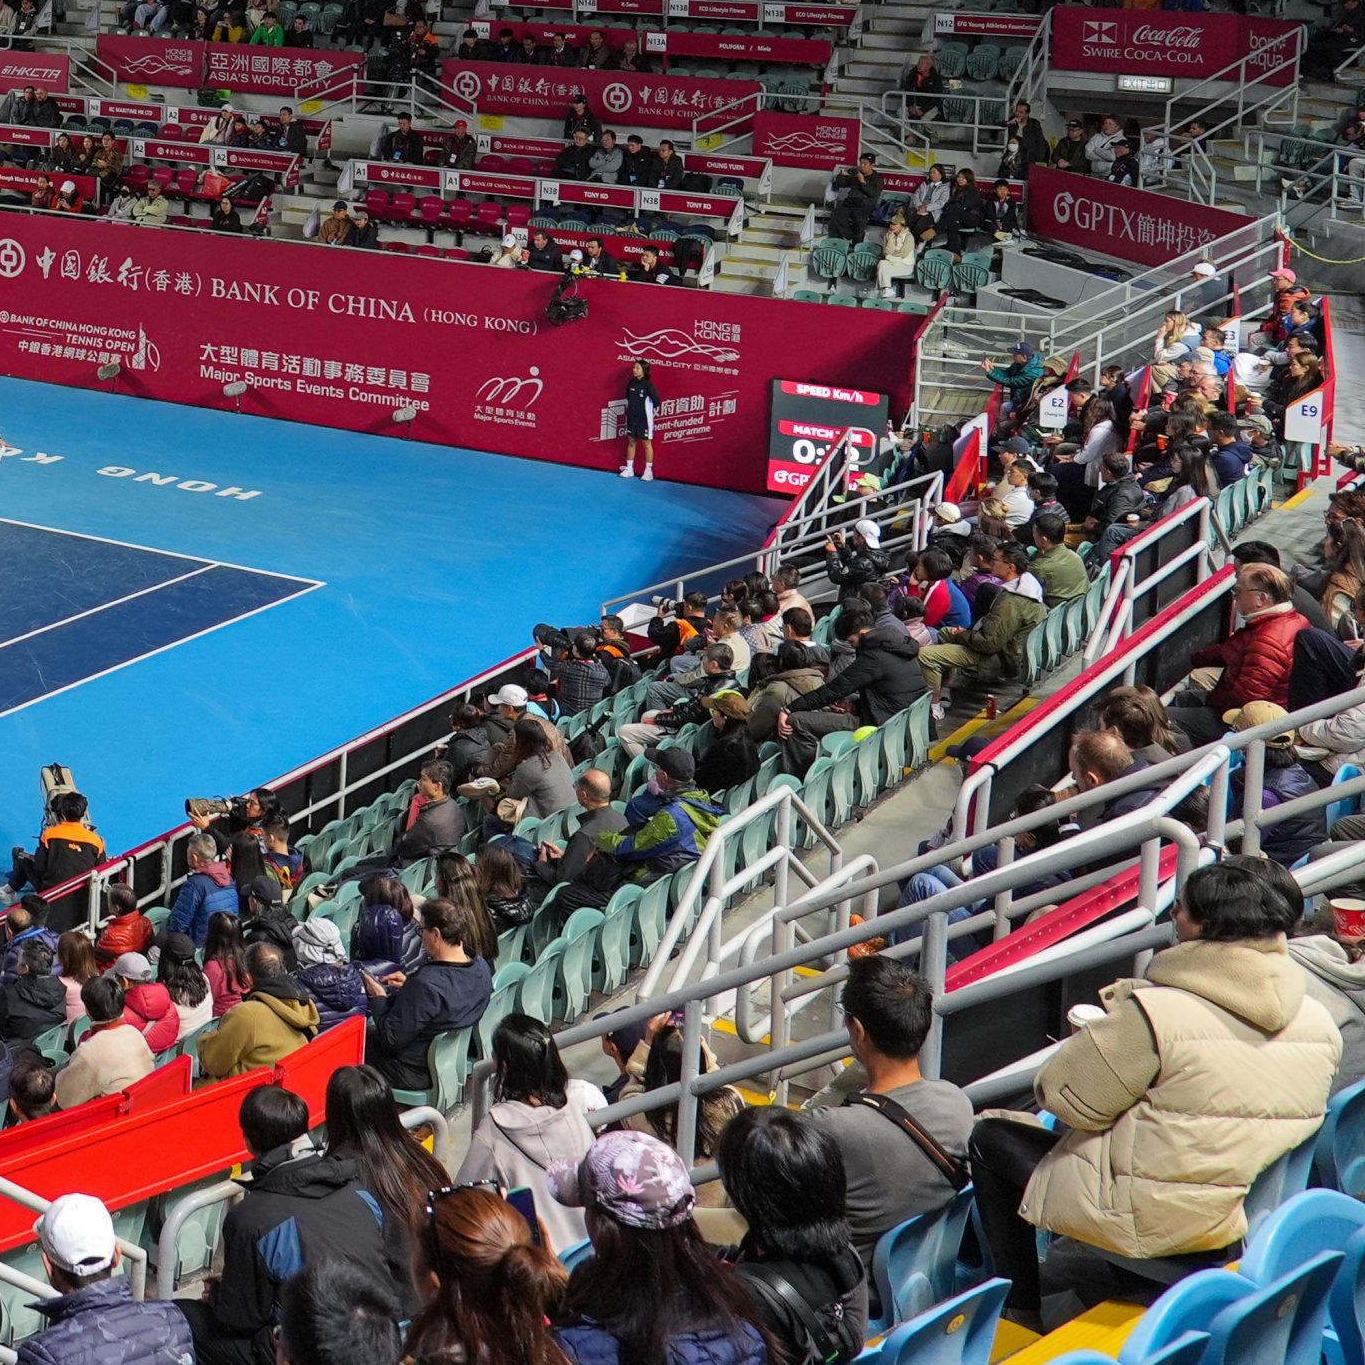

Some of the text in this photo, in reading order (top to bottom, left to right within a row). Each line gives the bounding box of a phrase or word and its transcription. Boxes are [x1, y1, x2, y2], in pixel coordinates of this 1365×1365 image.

[937, 19, 954, 29] N12
[1082, 45, 1204, 64] SWIRE COCA-COLA
[210, 52, 334, 78] 亞洲國際都會
[209, 71, 249, 83] ASIA'S
[251, 75, 297, 87] WORLD
[542, 185, 558, 196] N3B
[583, 191, 609, 200] TONY KO
[211, 278, 538, 336] BANK OF CHINA (HONG KONG)
[10, 313, 136, 340] BANK OF CHINA HONG KONG
[694, 319, 731, 333] HONG
[65, 332, 135, 352] TENNIS OPEN
[694, 329, 731, 343] KONG
[18, 338, 121, 365] 中銀香港網球公開賽
[199, 342, 431, 393] 大型體育活動事務委員會
[199, 365, 430, 412] Major Sports Events Committee
[796, 383, 864, 403] SPEED Km/h
[1051, 397, 1065, 409] E2
[1301, 404, 1318, 418] E9
[473, 405, 536, 420] 大型體育活動
[473, 412, 537, 428] Major Sports Events
[663, 425, 711, 439] programme
[792, 423, 834, 439] MATCH
[96, 465, 263, 501] HONG
